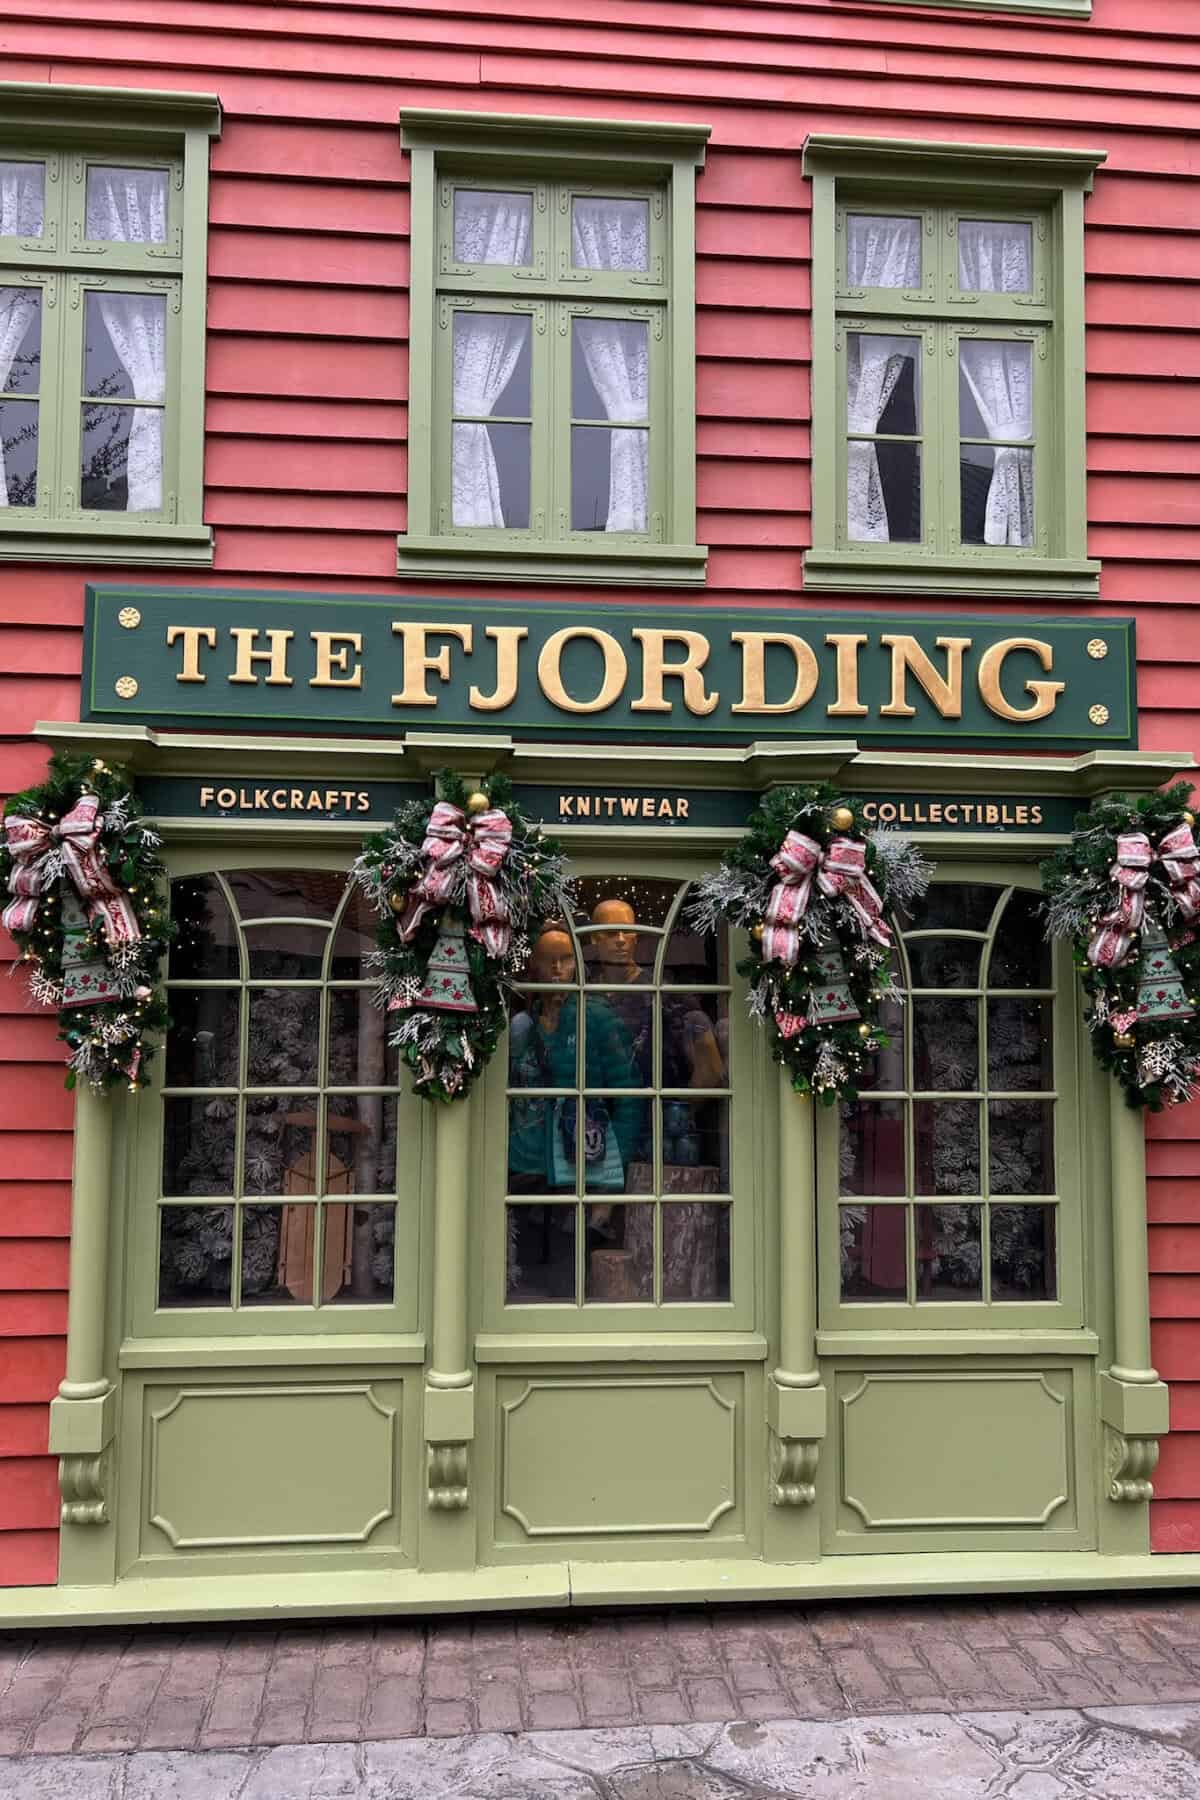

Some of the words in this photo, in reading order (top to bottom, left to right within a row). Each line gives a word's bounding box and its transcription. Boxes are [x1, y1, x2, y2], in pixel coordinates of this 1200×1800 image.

[167, 626, 363, 688] THE
[391, 622, 1066, 723] FJORDING
[200, 787, 370, 812] FOLKCRAFTS
[558, 796, 690, 819] KNITWEAR
[862, 802, 1043, 825] COLLECTIBLES
